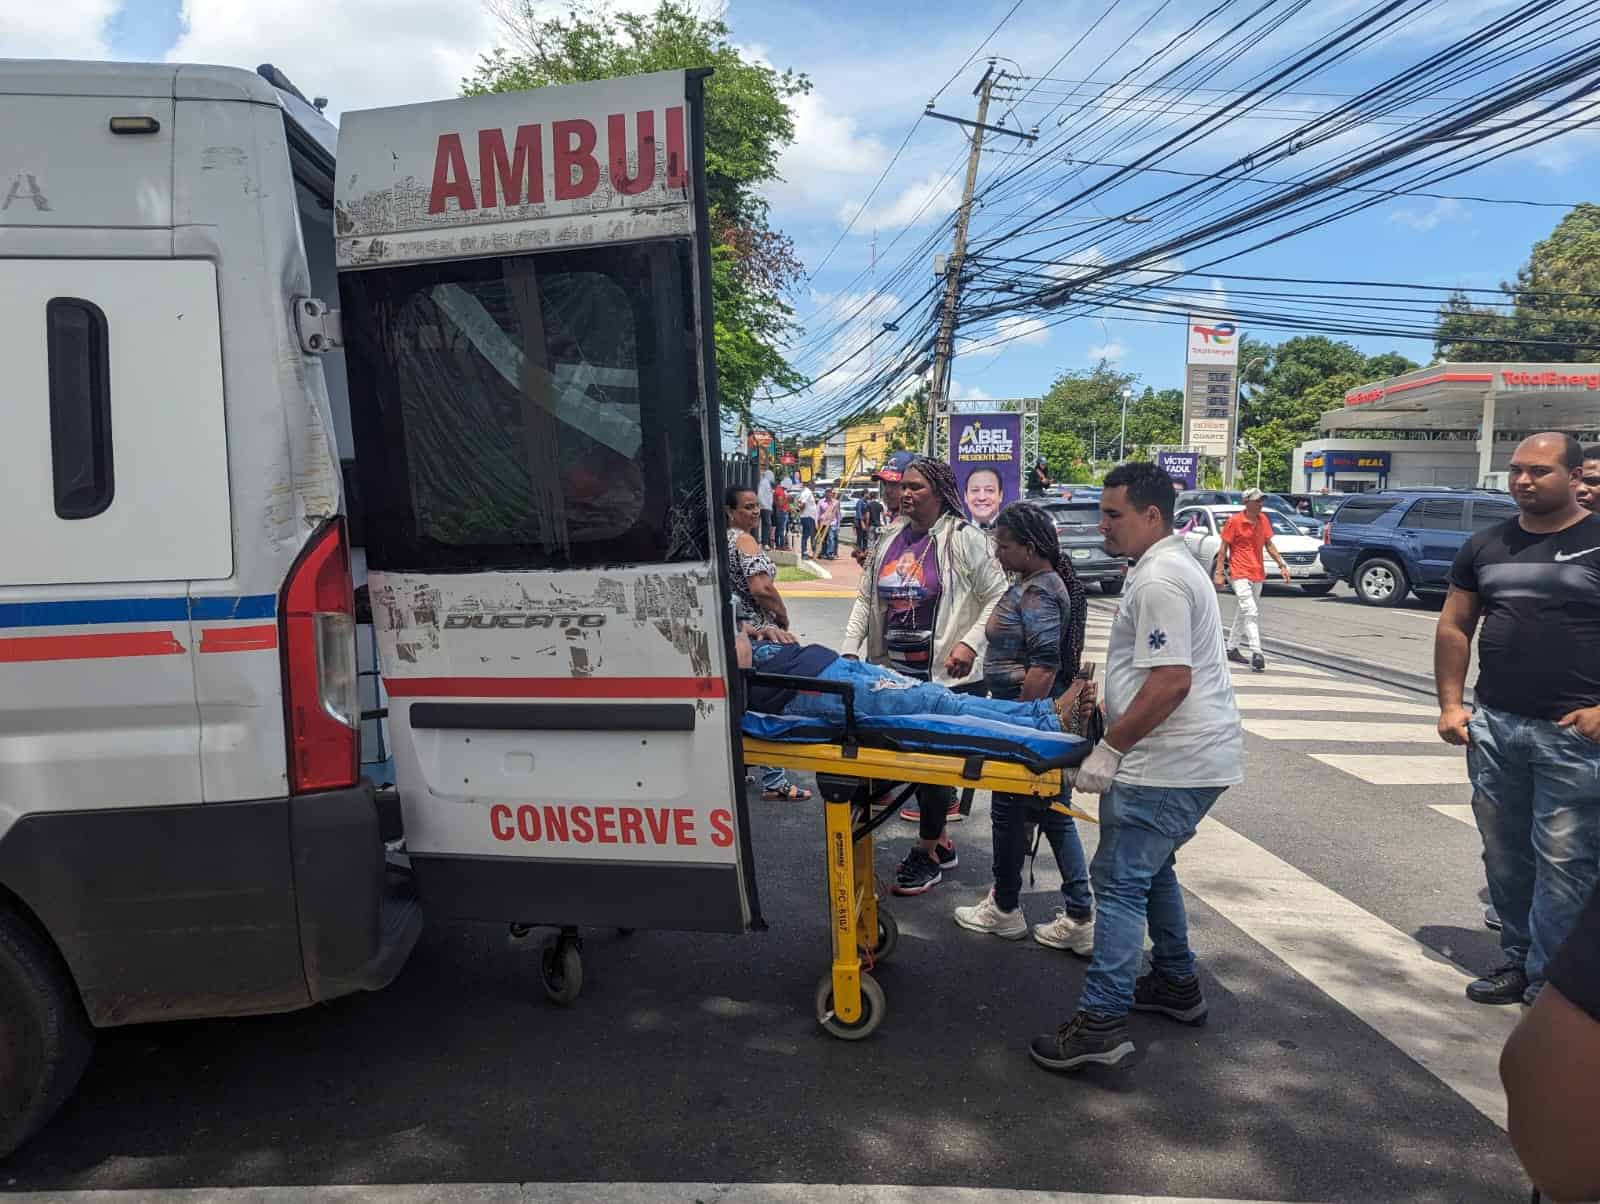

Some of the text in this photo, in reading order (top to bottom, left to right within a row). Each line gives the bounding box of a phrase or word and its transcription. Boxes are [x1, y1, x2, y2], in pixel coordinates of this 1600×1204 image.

[959, 423, 1013, 445] ABEL
[443, 613, 607, 629] DUCATO
[490, 803, 697, 847] CONSERVE
